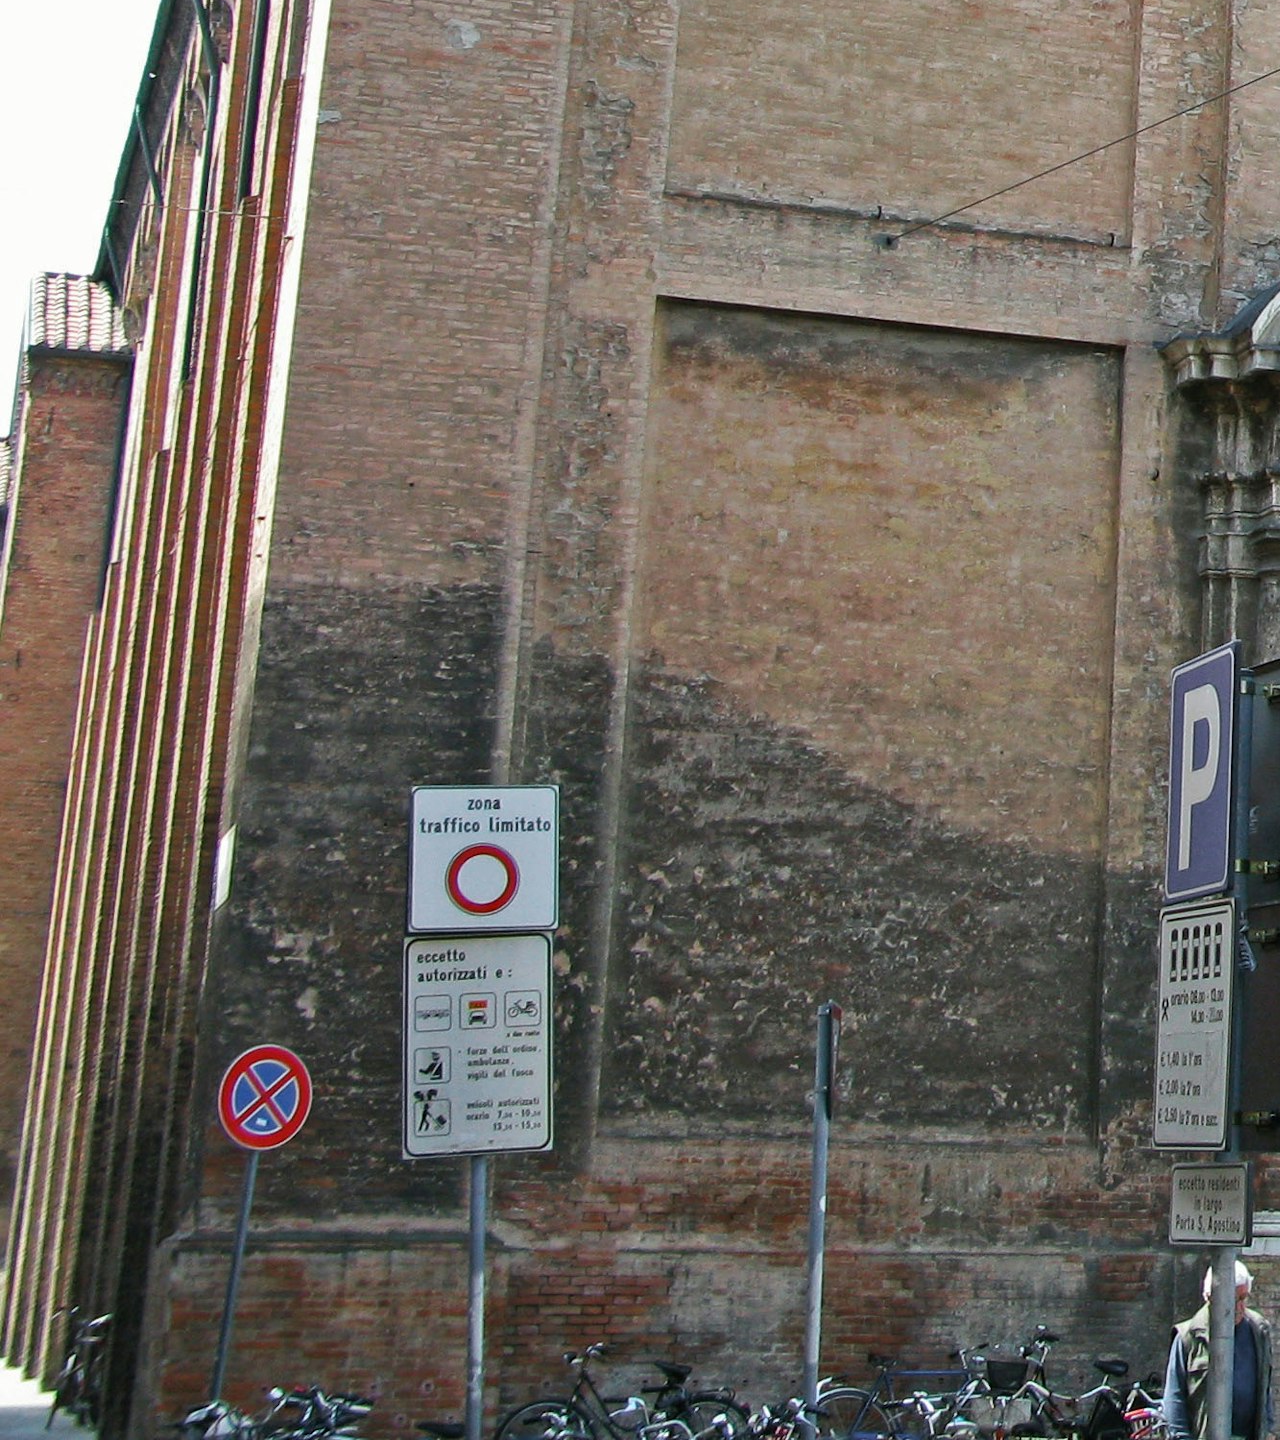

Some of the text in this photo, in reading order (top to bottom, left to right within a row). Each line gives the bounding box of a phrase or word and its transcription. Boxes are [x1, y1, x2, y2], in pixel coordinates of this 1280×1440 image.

[1177, 683, 1221, 872] P
[467, 798, 501, 811] zona
[419, 815, 552, 833] traffico limitato
[416, 949, 466, 964] eccetto
[417, 965, 487, 982] autorizzati
[1170, 989, 1189, 1006] orario
[467, 1047, 488, 1055] forze
[493, 1069, 506, 1078] del
[511, 1068, 534, 1078] fuoco
[466, 1111, 490, 1121] orario
[1178, 1175, 1240, 1191] eccetto residenti
[1194, 1195, 1222, 1215] in largo
[1175, 1214, 1195, 1230] Porta
[1207, 1215, 1241, 1235] Agostino
